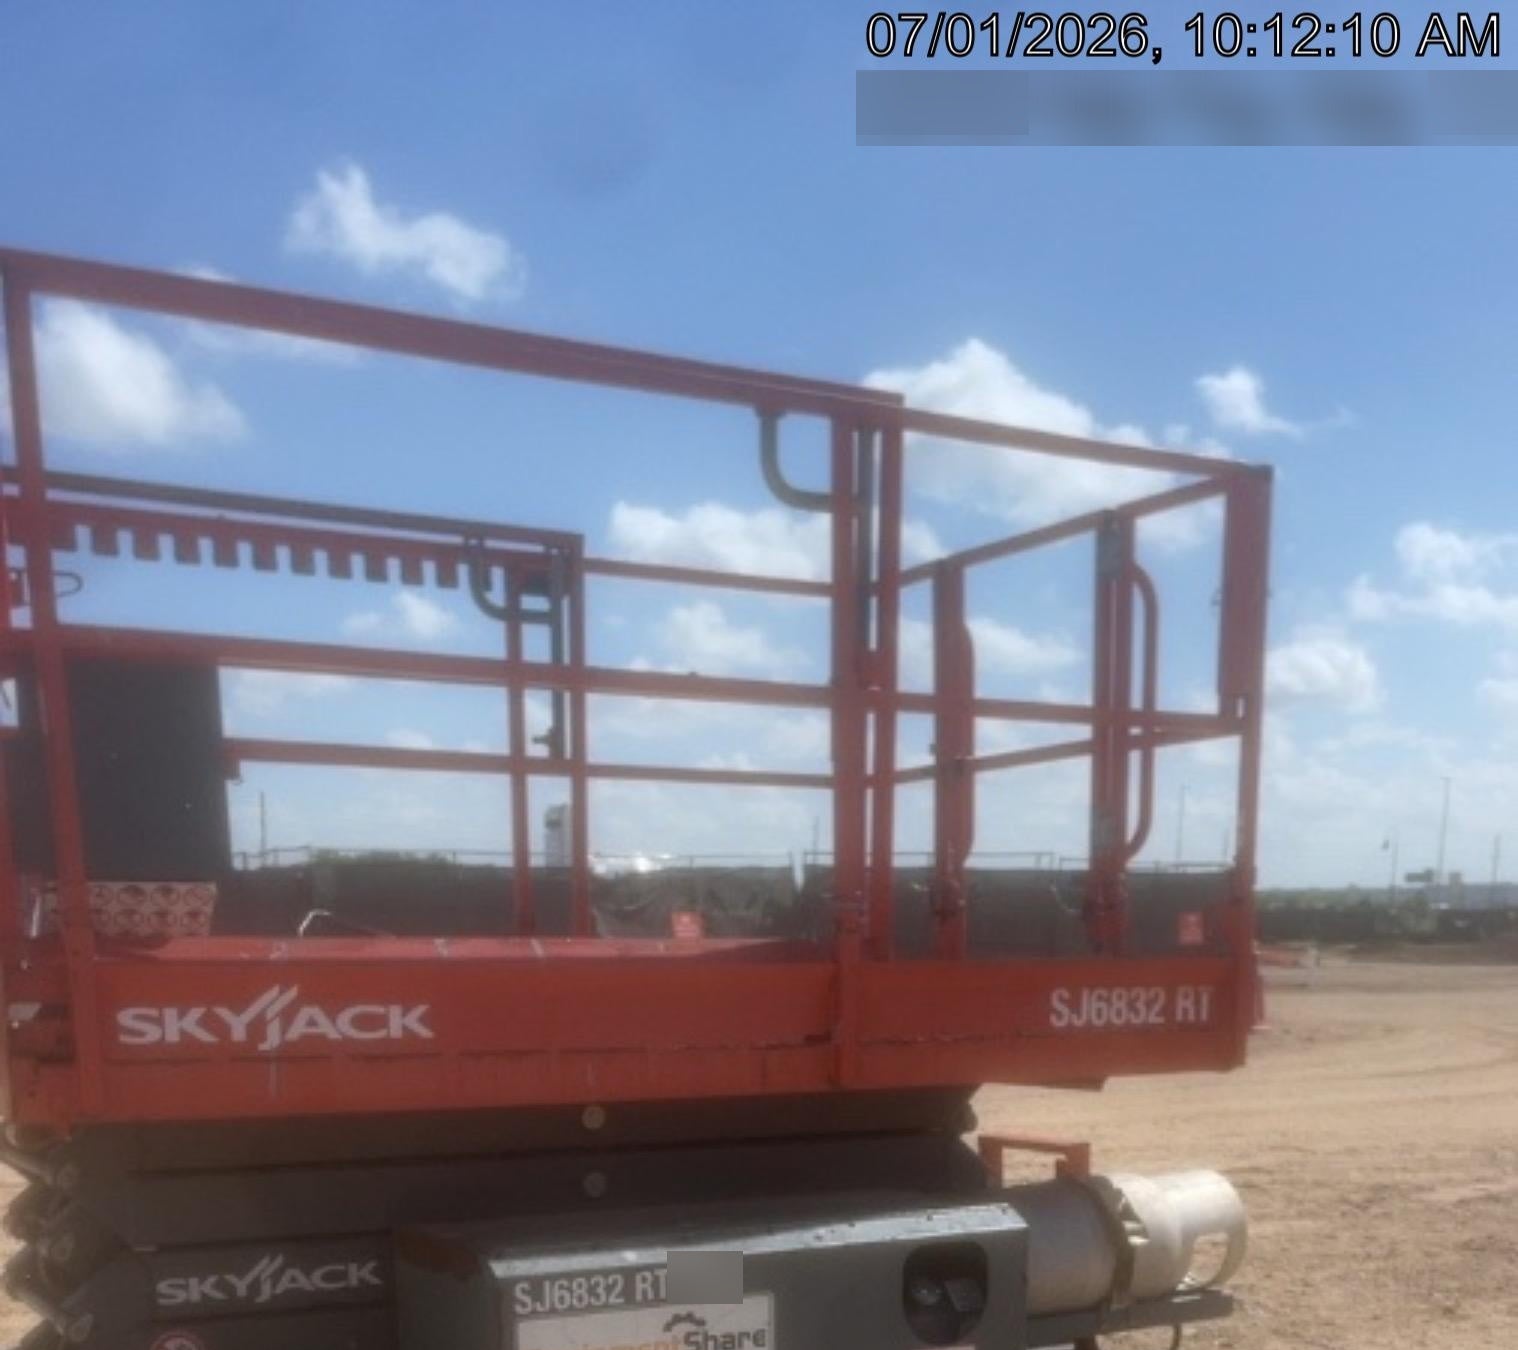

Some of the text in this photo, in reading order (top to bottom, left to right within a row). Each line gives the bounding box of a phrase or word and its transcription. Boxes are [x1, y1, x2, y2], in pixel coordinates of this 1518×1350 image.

[116, 984, 434, 1051] SKYJACK
[1050, 984, 1216, 1028] SJ6832 RT
[156, 1254, 383, 1306] SKYJACK
[514, 1269, 667, 1315] SJ6832 RT
